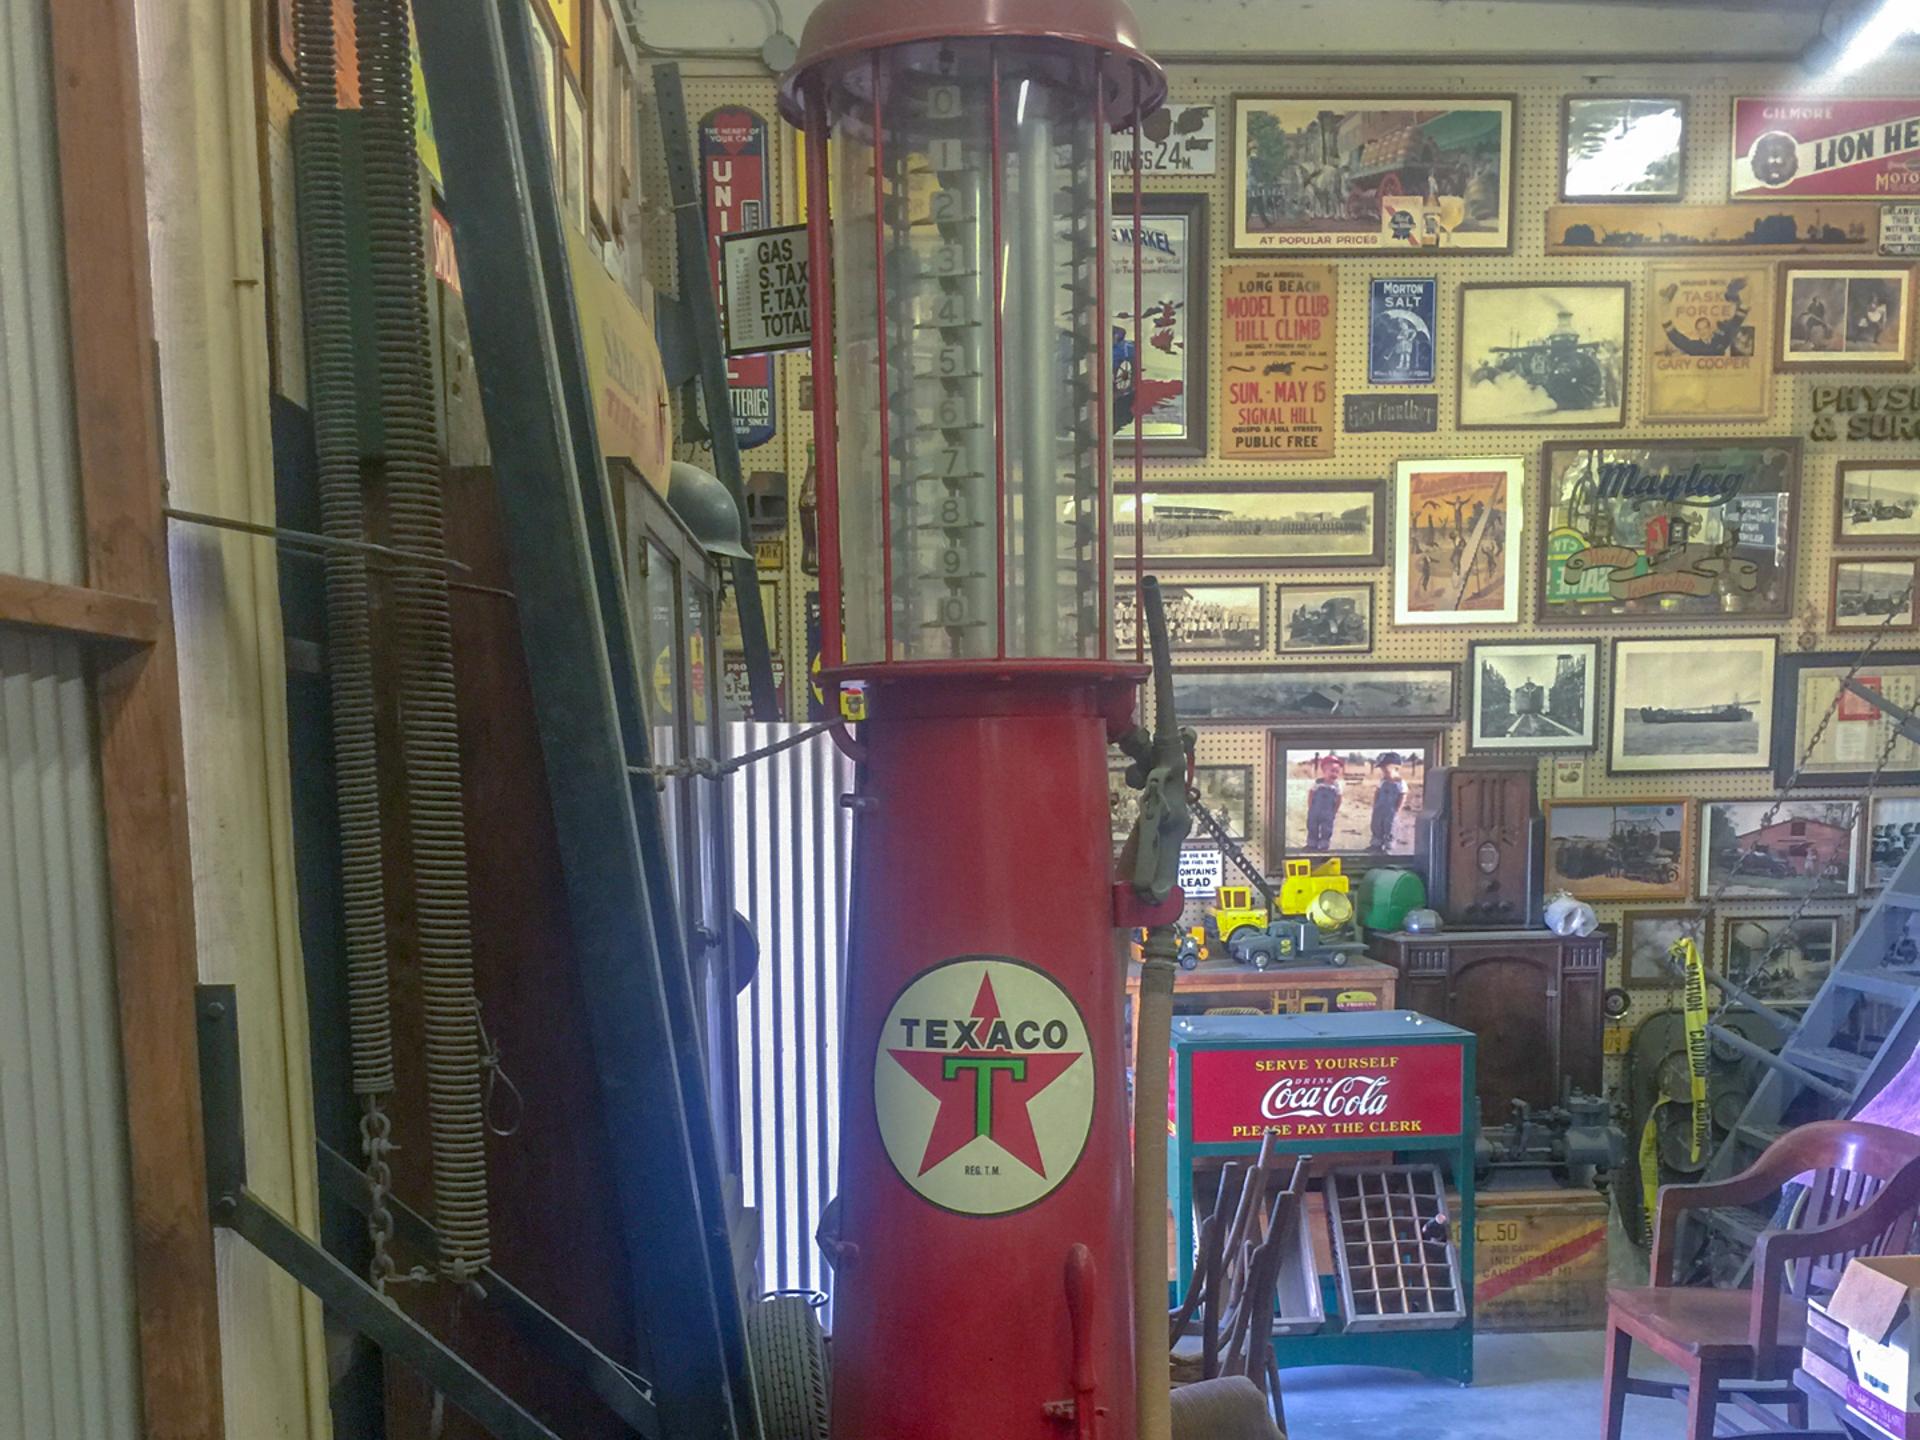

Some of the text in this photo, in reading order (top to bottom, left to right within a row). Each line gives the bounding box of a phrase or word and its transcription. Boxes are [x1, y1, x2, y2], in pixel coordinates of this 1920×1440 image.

[1762, 107, 1833, 119] GILMORE
[710, 135, 734, 143] YOUR
[1814, 120, 1920, 171] LION HE
[1155, 142, 1182, 170] 24
[1876, 172, 1920, 191] MOTO
[936, 193, 956, 215] 2
[1259, 235, 1378, 245] AT POPULAR PRICES
[757, 238, 793, 265] GAS
[938, 247, 957, 273] 3
[758, 261, 809, 289] S. TAX
[1238, 280, 1321, 293] LONG BEACH
[1683, 290, 1725, 303] TASK
[760, 286, 809, 314] F. TAX
[1225, 295, 1330, 319] MODEL T CLUB
[1384, 297, 1422, 308] SALT
[1676, 305, 1732, 317] FORCE
[937, 301, 958, 322] 4
[761, 309, 811, 338] TOTAL
[1235, 318, 1322, 342] HILL CLIMB
[939, 349, 956, 374] 5
[1657, 357, 1750, 371] GARY COOPER
[1229, 382, 1264, 405] SUN.
[1274, 381, 1309, 403] MAY
[1312, 381, 1326, 403] 15
[1812, 385, 1920, 413] PHYSI
[748, 418, 769, 426] SINCE
[939, 401, 958, 422] 6
[1238, 406, 1317, 425] SIGNAL HILL
[1810, 413, 1920, 442] & SUR
[1235, 435, 1319, 448] PUBLIC FREE
[942, 449, 959, 473] 7
[1597, 464, 1745, 512] Maytag
[941, 499, 960, 524] 8
[943, 549, 961, 574] 9
[1179, 868, 1218, 877] ONTAINS
[1180, 877, 1211, 888] LEAD
[1686, 962, 1704, 1012] CAUTION
[899, 1018, 1069, 1051] TEXACO
[1255, 1057, 1400, 1072] SERVE YOURSELF
[1294, 1077, 1334, 1085] DRINK
[1260, 1075, 1390, 1119] Coca-Cola
[1232, 1120, 1423, 1137] PLEASE PAY THE CLERK
[964, 1165, 983, 1177] REG.
